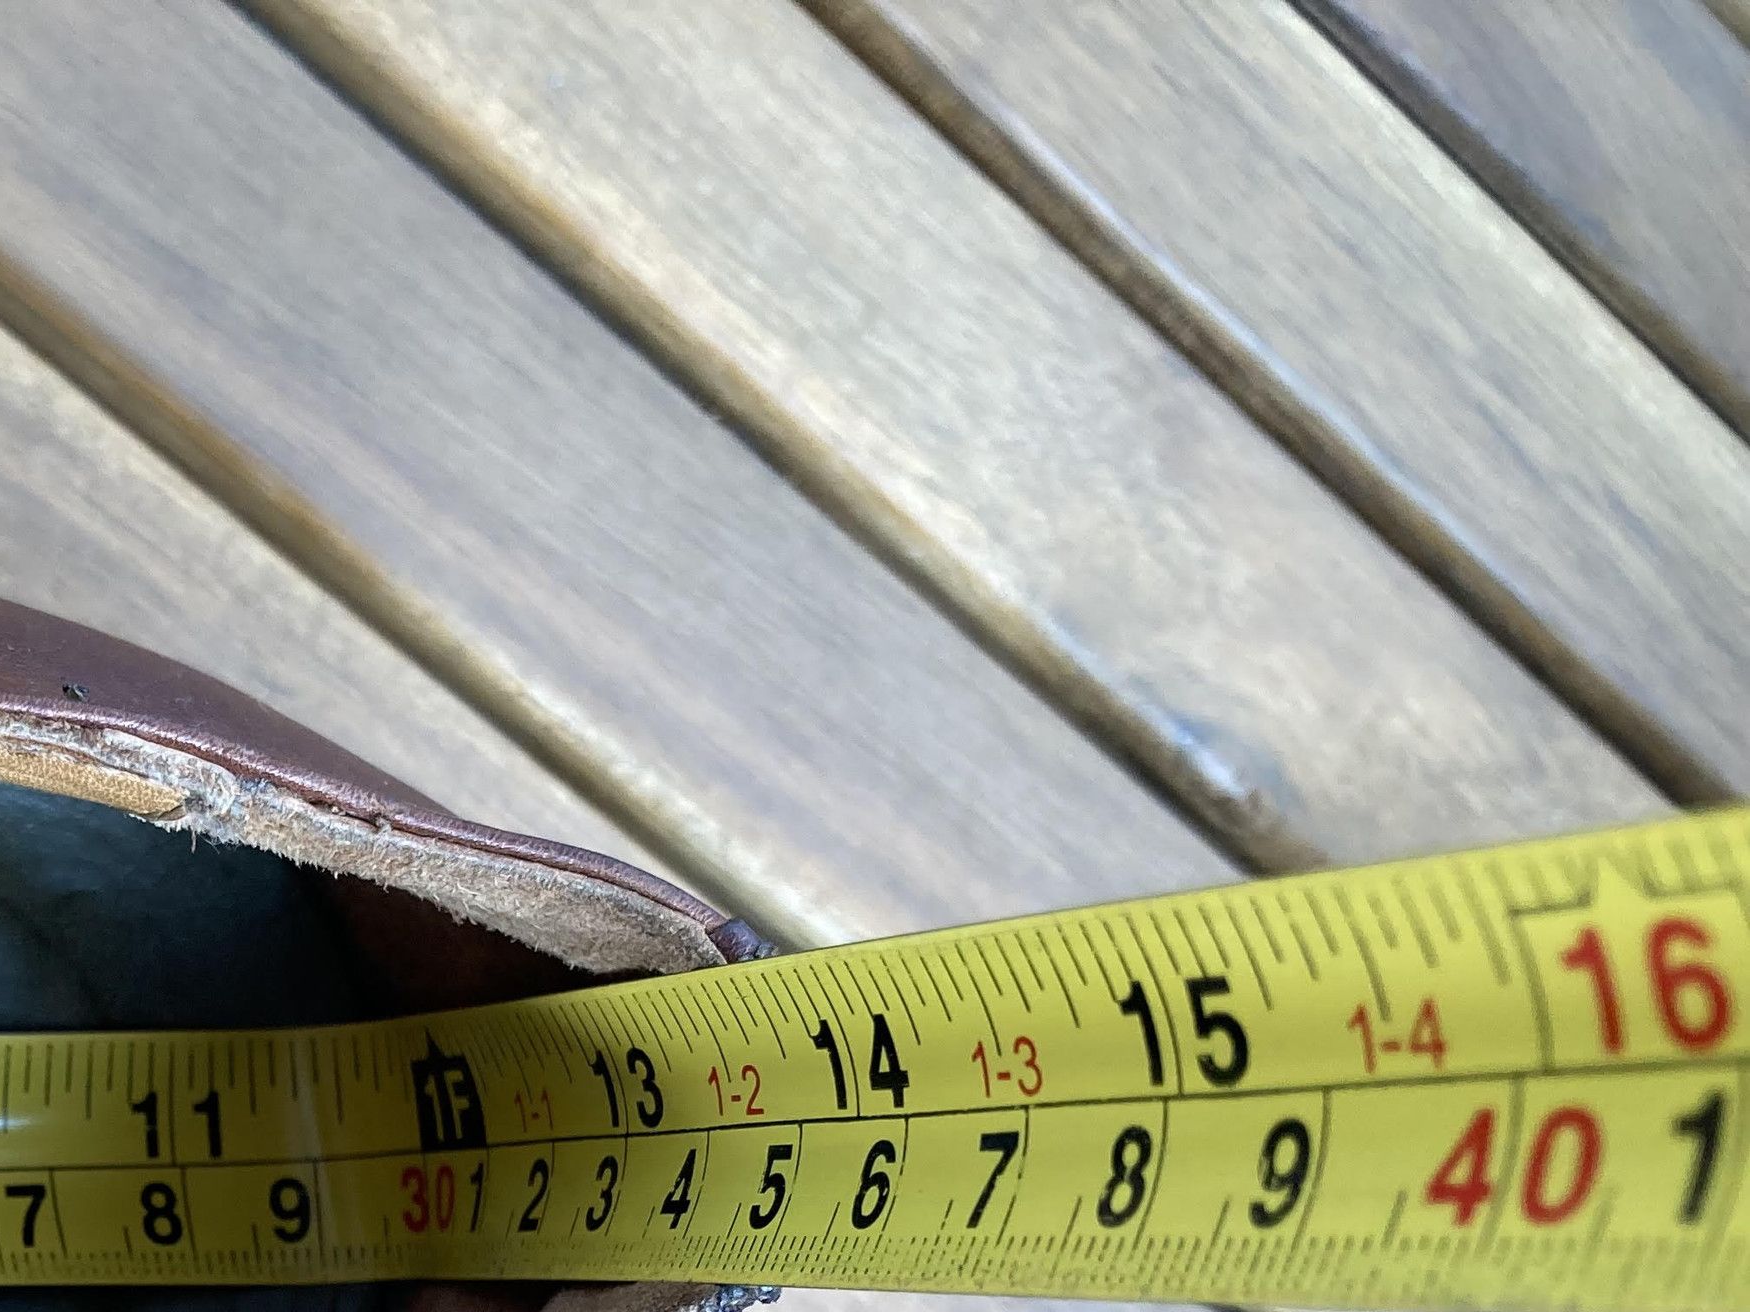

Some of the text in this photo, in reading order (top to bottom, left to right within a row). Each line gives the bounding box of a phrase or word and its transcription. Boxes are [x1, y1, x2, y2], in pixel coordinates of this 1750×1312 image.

[131, 1091, 223, 1159] 11
[513, 1087, 551, 1133] 1-1
[587, 1046, 664, 1129] 13
[708, 1064, 764, 1116] 1-2
[810, 1013, 909, 1110] 14
[971, 1036, 1043, 1098] 1-3
[1120, 975, 1249, 1086] 15
[1347, 996, 1447, 1075] 1-4
[1559, 914, 1735, 1055] 16
[4, 1185, 47, 1249] 7
[140, 1183, 183, 1246] 8
[269, 1177, 310, 1243] 9
[401, 1165, 454, 1233] 30
[468, 1161, 485, 1233] 1
[517, 1158, 549, 1232] 2
[585, 1155, 618, 1233] 3
[660, 1148, 696, 1230] 4
[749, 1144, 793, 1230] 5
[851, 1139, 896, 1230] 6
[966, 1130, 1020, 1229] 7
[1096, 1125, 1151, 1229] 8
[1249, 1118, 1310, 1229] 9
[1425, 1105, 1602, 1227] 40
[1672, 1087, 1728, 1225] 1
